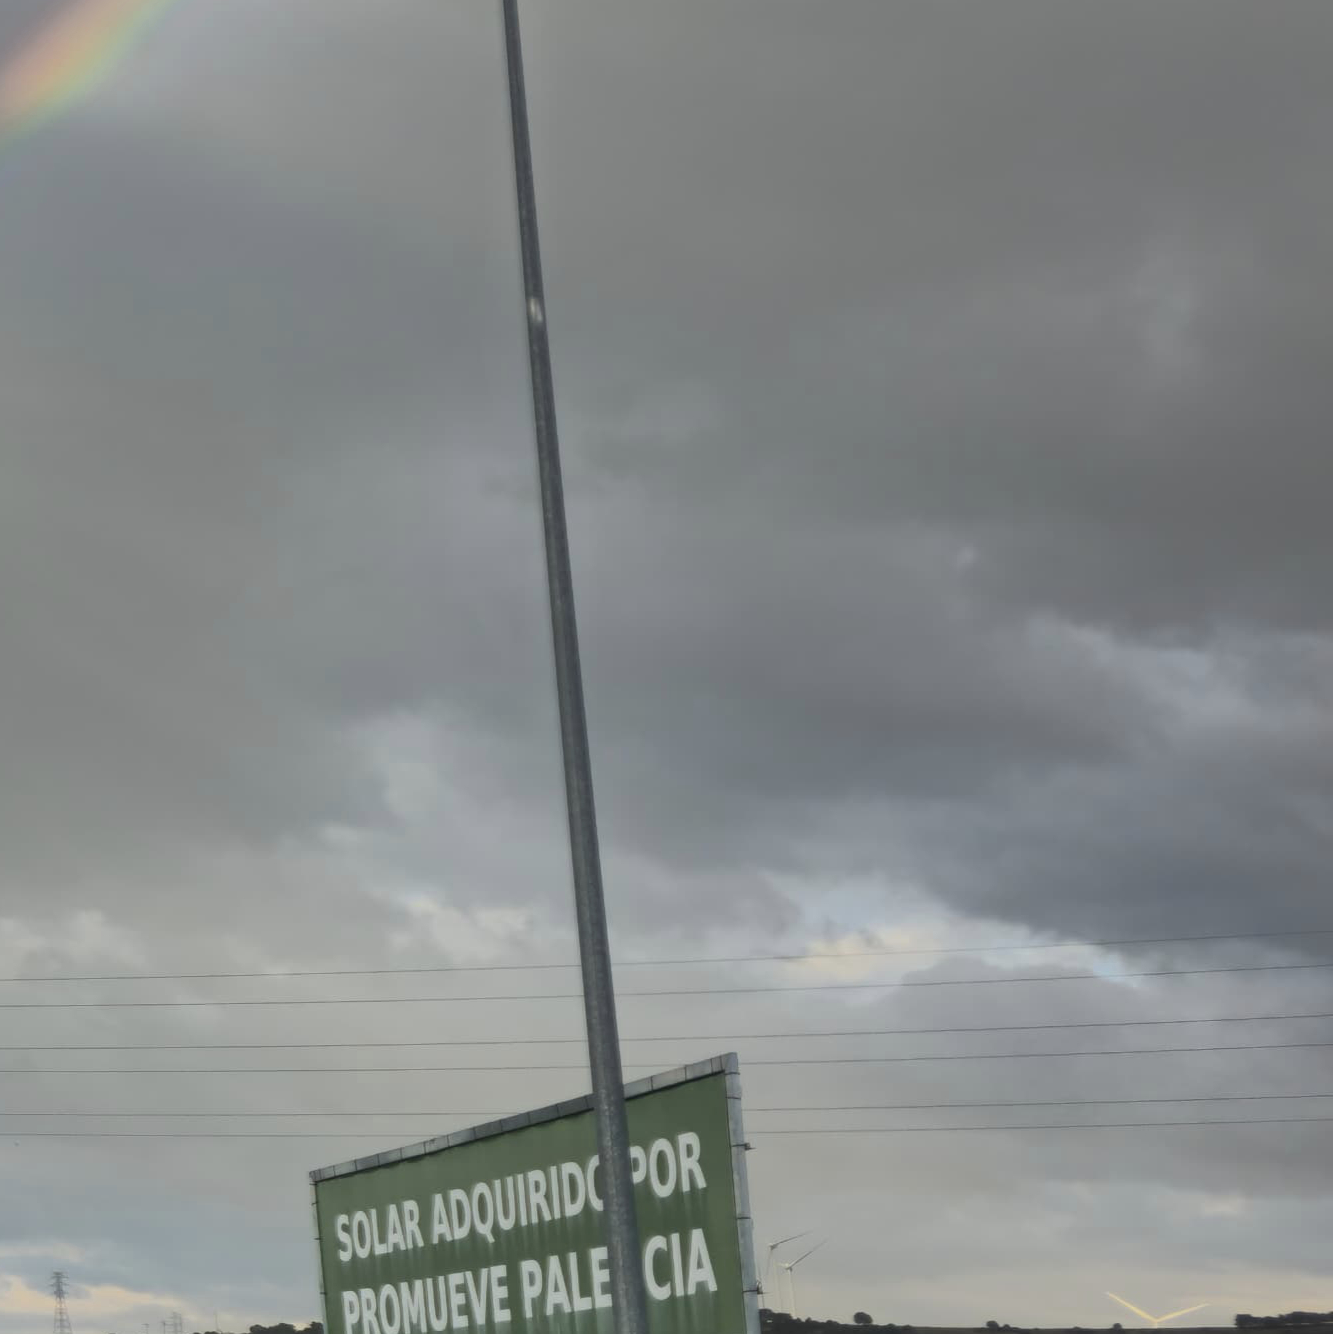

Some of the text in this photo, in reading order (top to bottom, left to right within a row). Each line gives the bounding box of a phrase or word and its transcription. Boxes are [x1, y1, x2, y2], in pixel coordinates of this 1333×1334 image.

[336, 1199, 425, 1262] SOLAR
[629, 1131, 707, 1198] POR
[520, 1228, 718, 1320] PALECIA
